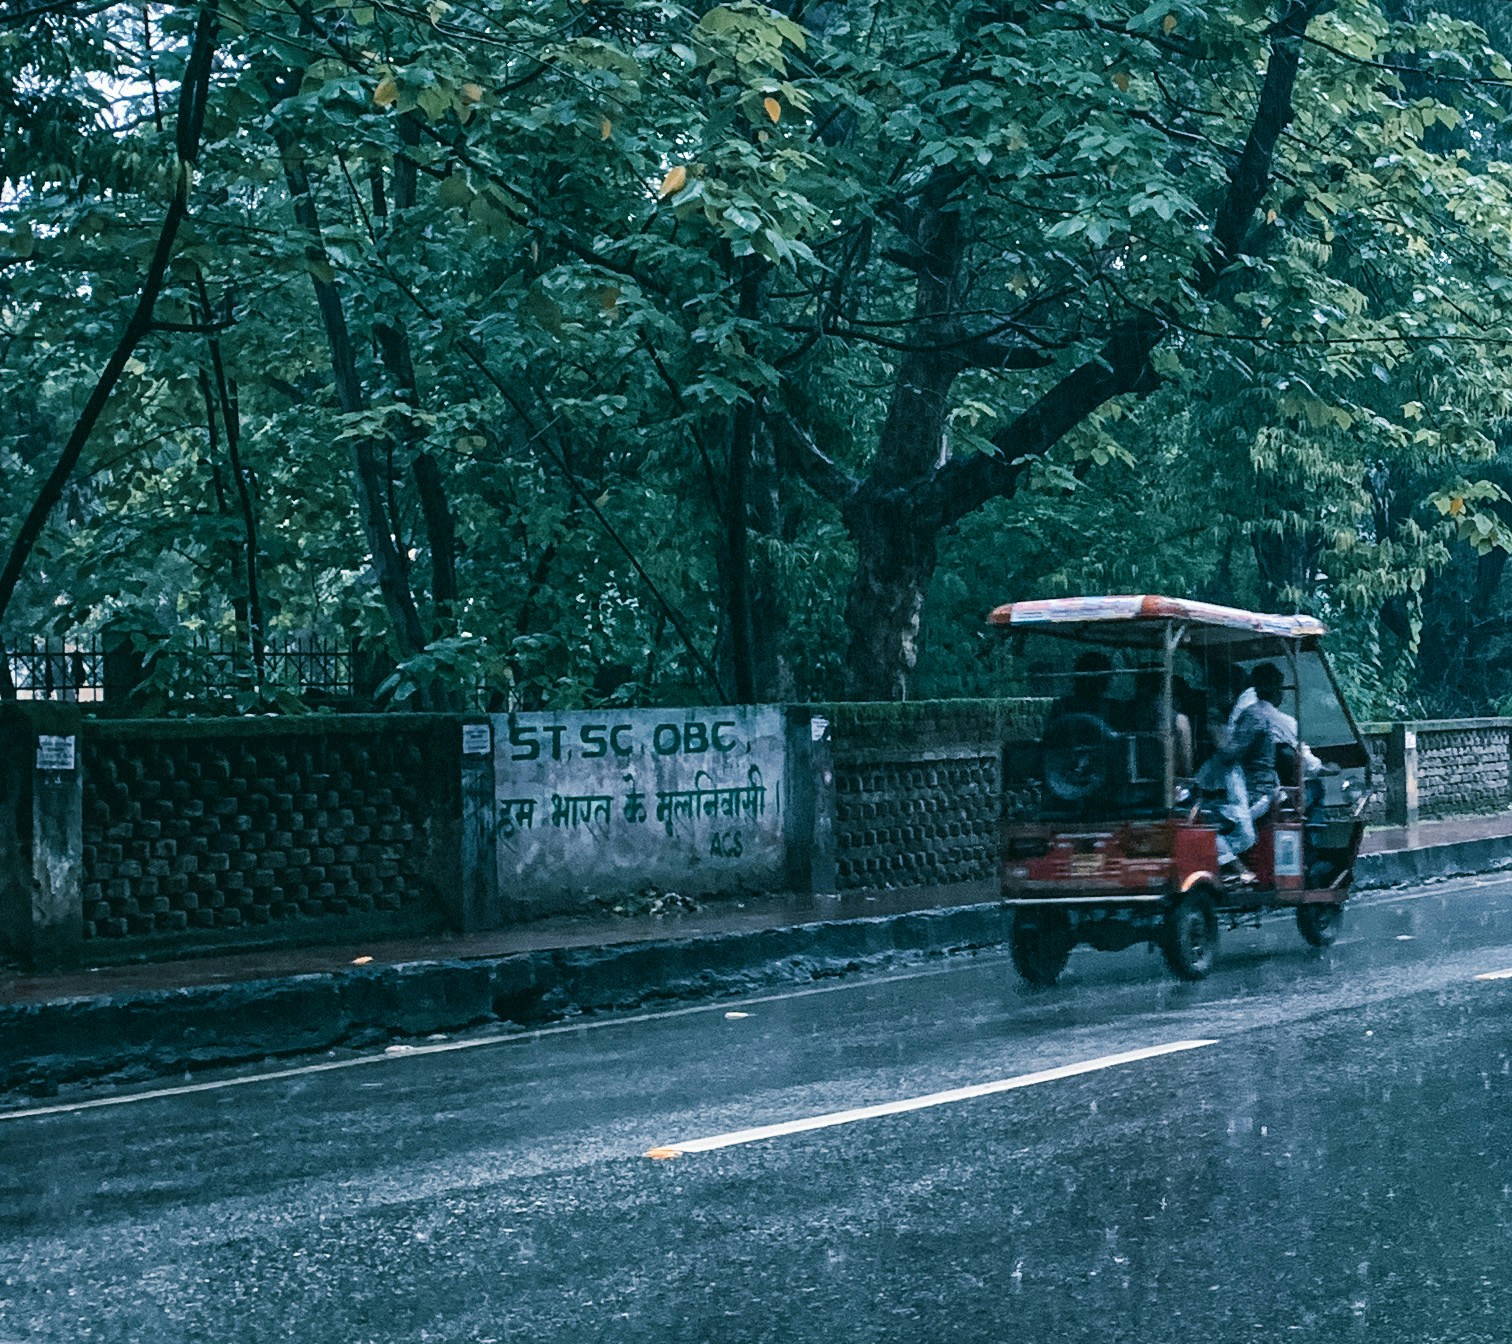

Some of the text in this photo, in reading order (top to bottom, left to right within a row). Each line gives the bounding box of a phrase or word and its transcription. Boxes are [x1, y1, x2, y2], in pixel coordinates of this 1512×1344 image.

[498, 798, 538, 841] हम
[551, 793, 614, 840] भारत
[622, 773, 647, 824] के
